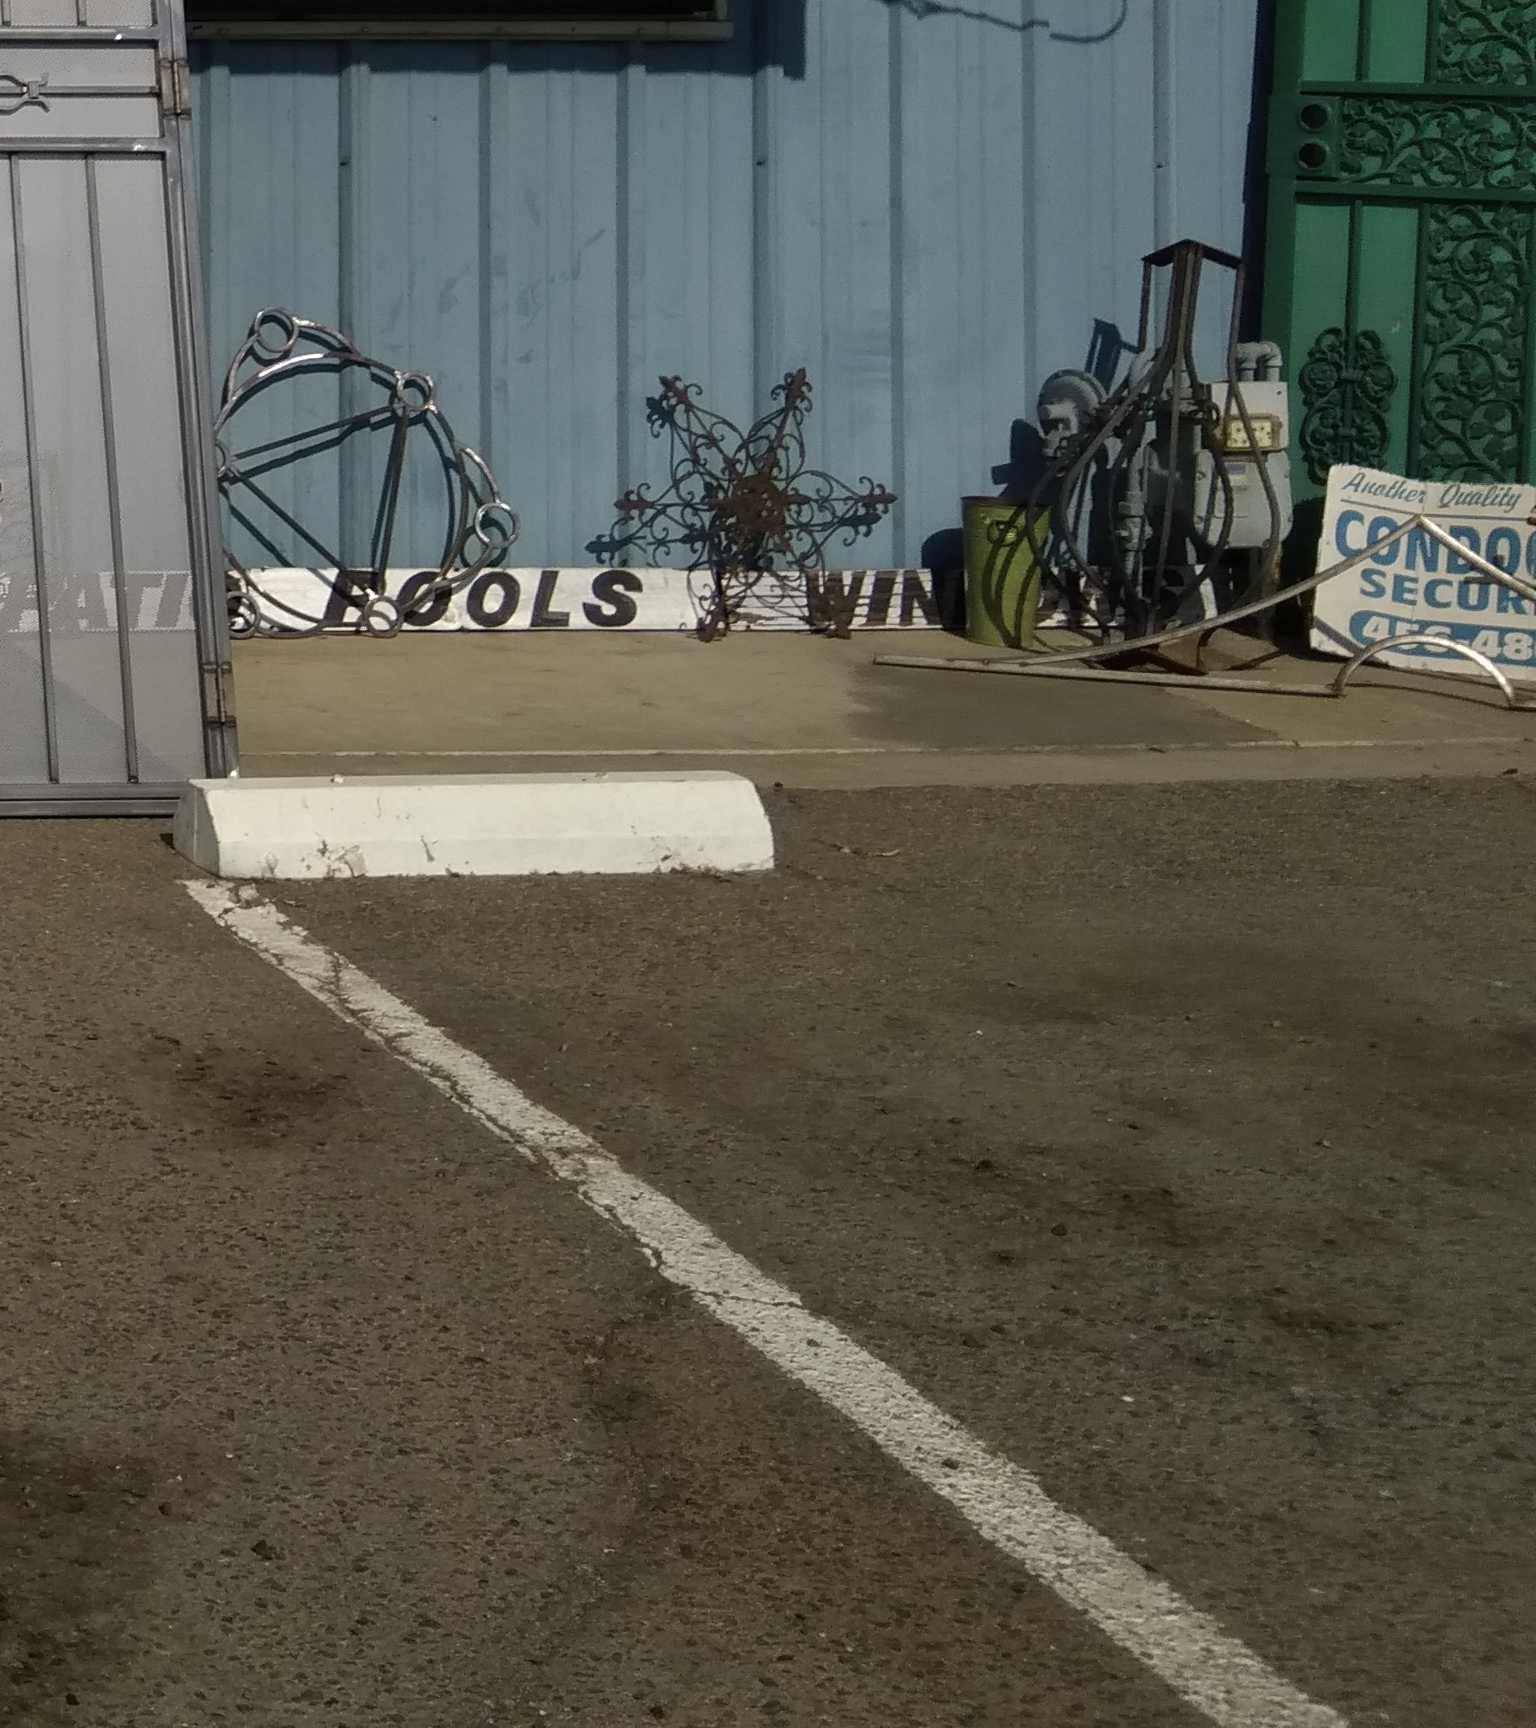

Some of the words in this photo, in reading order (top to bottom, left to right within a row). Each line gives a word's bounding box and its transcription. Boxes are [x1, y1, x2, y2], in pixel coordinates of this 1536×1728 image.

[1342, 472, 1427, 503] Another
[1438, 484, 1522, 513] Quality
[1359, 568, 1536, 616] SECUR
